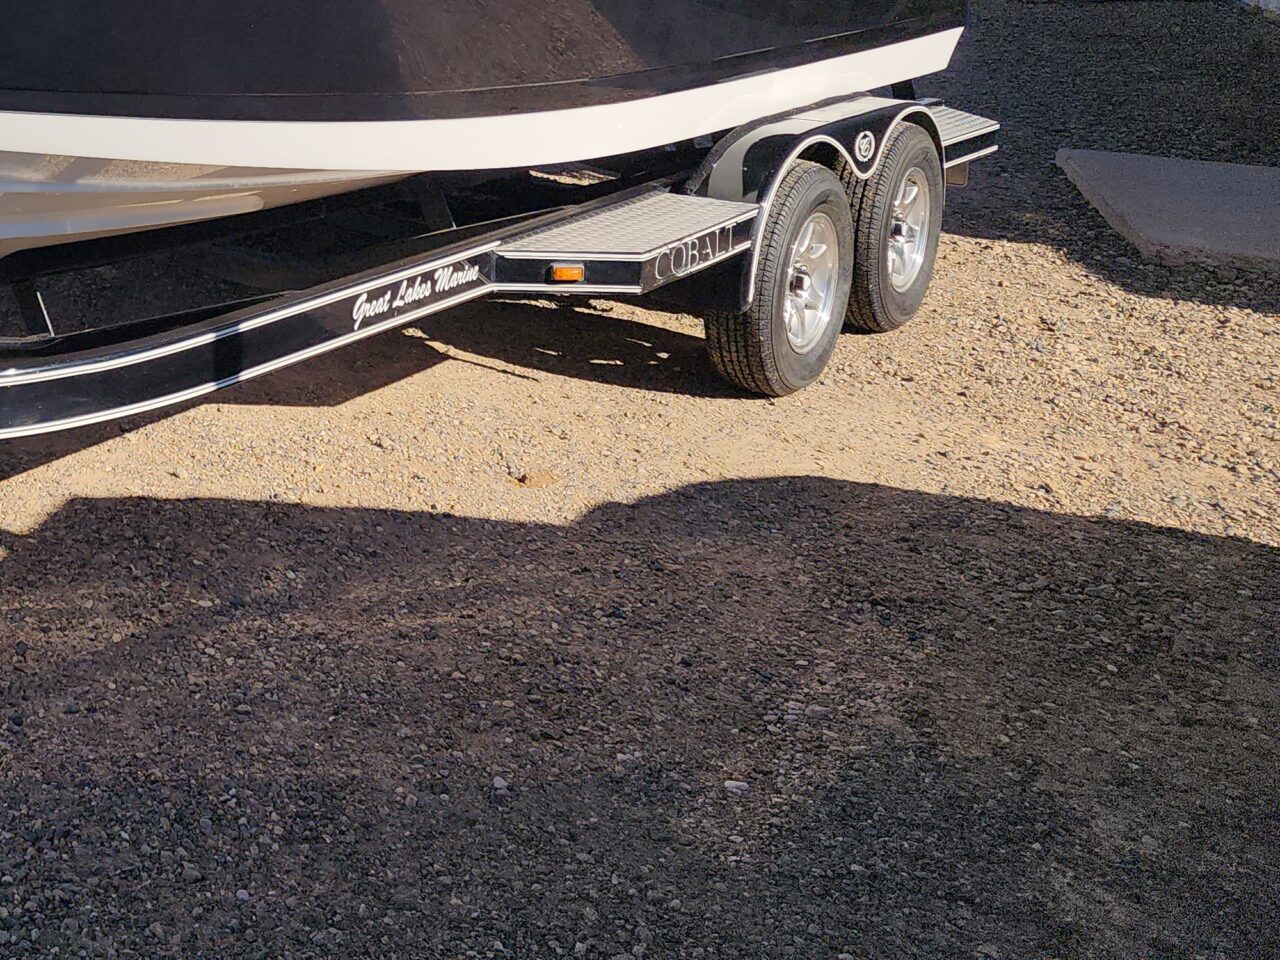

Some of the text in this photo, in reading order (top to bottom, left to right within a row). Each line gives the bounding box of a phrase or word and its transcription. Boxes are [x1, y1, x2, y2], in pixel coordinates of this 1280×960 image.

[655, 222, 737, 280] COBALT
[352, 265, 479, 331] Great Lakes Marine
